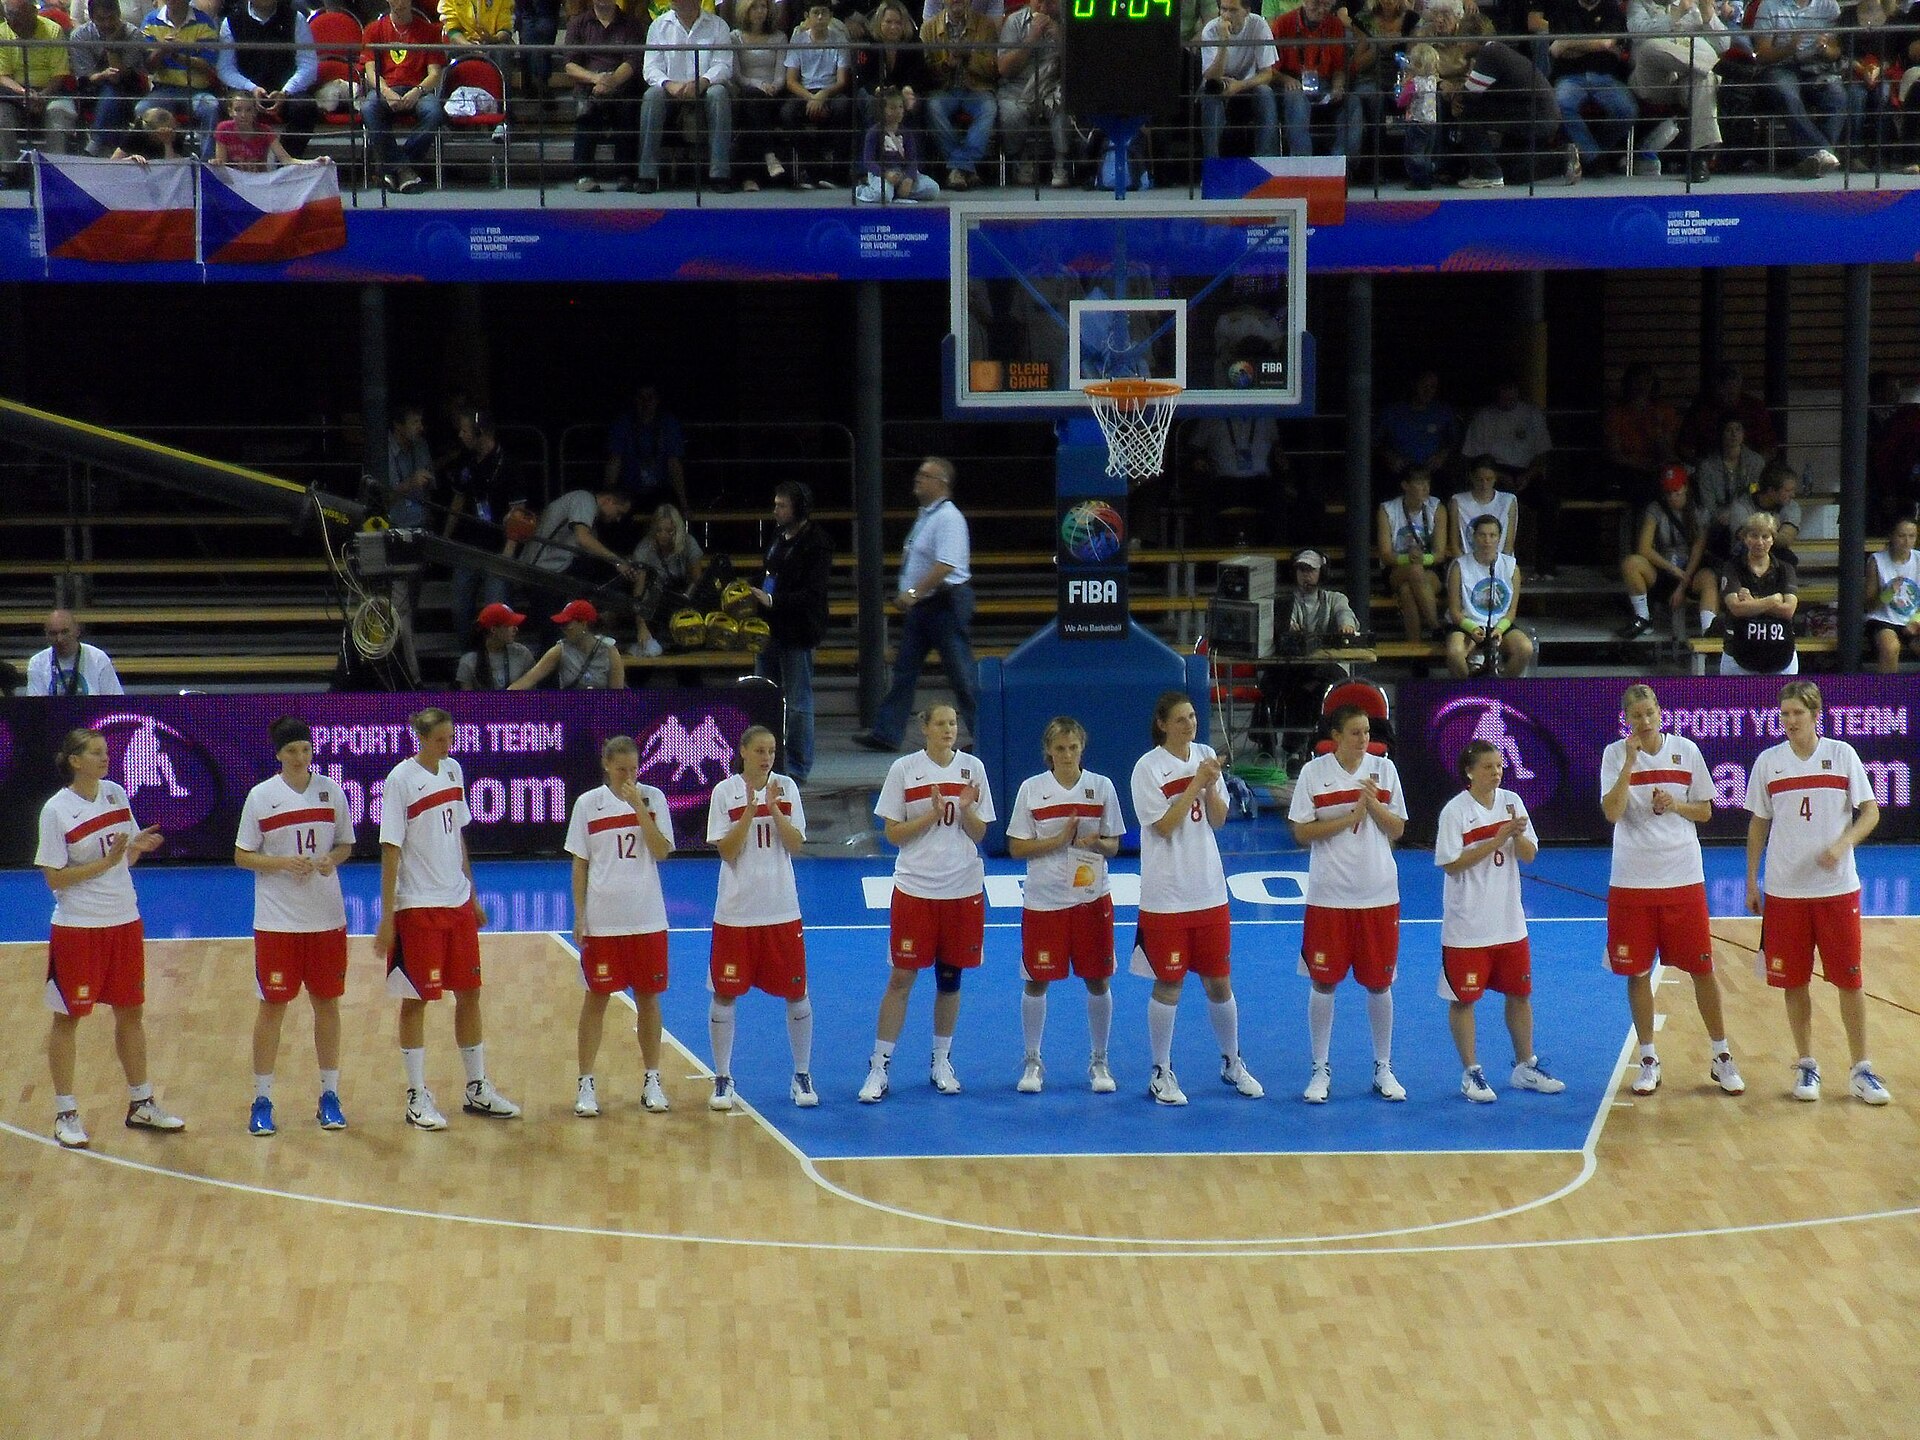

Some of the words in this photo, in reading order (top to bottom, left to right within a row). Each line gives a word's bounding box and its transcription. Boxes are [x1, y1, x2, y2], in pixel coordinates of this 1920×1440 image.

[1667, 219, 1690, 227] WORLD
[1691, 218, 1740, 227] CHAMPIONSHIP
[1667, 227, 1680, 236] FOR
[1681, 227, 1706, 236] WOMEN
[470, 235, 493, 243] WORLD
[860, 233, 882, 241] WORLD
[1009, 362, 1049, 375] CLEAN
[1261, 362, 1283, 373] FIBA
[1009, 375, 1048, 389] GAME
[1068, 579, 1118, 604] FIBA
[1064, 624, 1076, 632] We
[1077, 624, 1089, 632] Are
[1089, 623, 1122, 632] Basketball
[1747, 622, 1767, 640] PH
[1770, 623, 1785, 640] 92
[1618, 706, 1745, 738] SPPORT
[1829, 705, 1908, 736] TEAM
[309, 724, 405, 755] PPORT
[486, 721, 564, 752] TEAM
[1191, 798, 1203, 822] 8
[1800, 796, 1812, 821] 4
[442, 808, 453, 835] 13
[296, 828, 317, 855] 14
[617, 833, 637, 859] 12
[757, 823, 771, 849] 11
